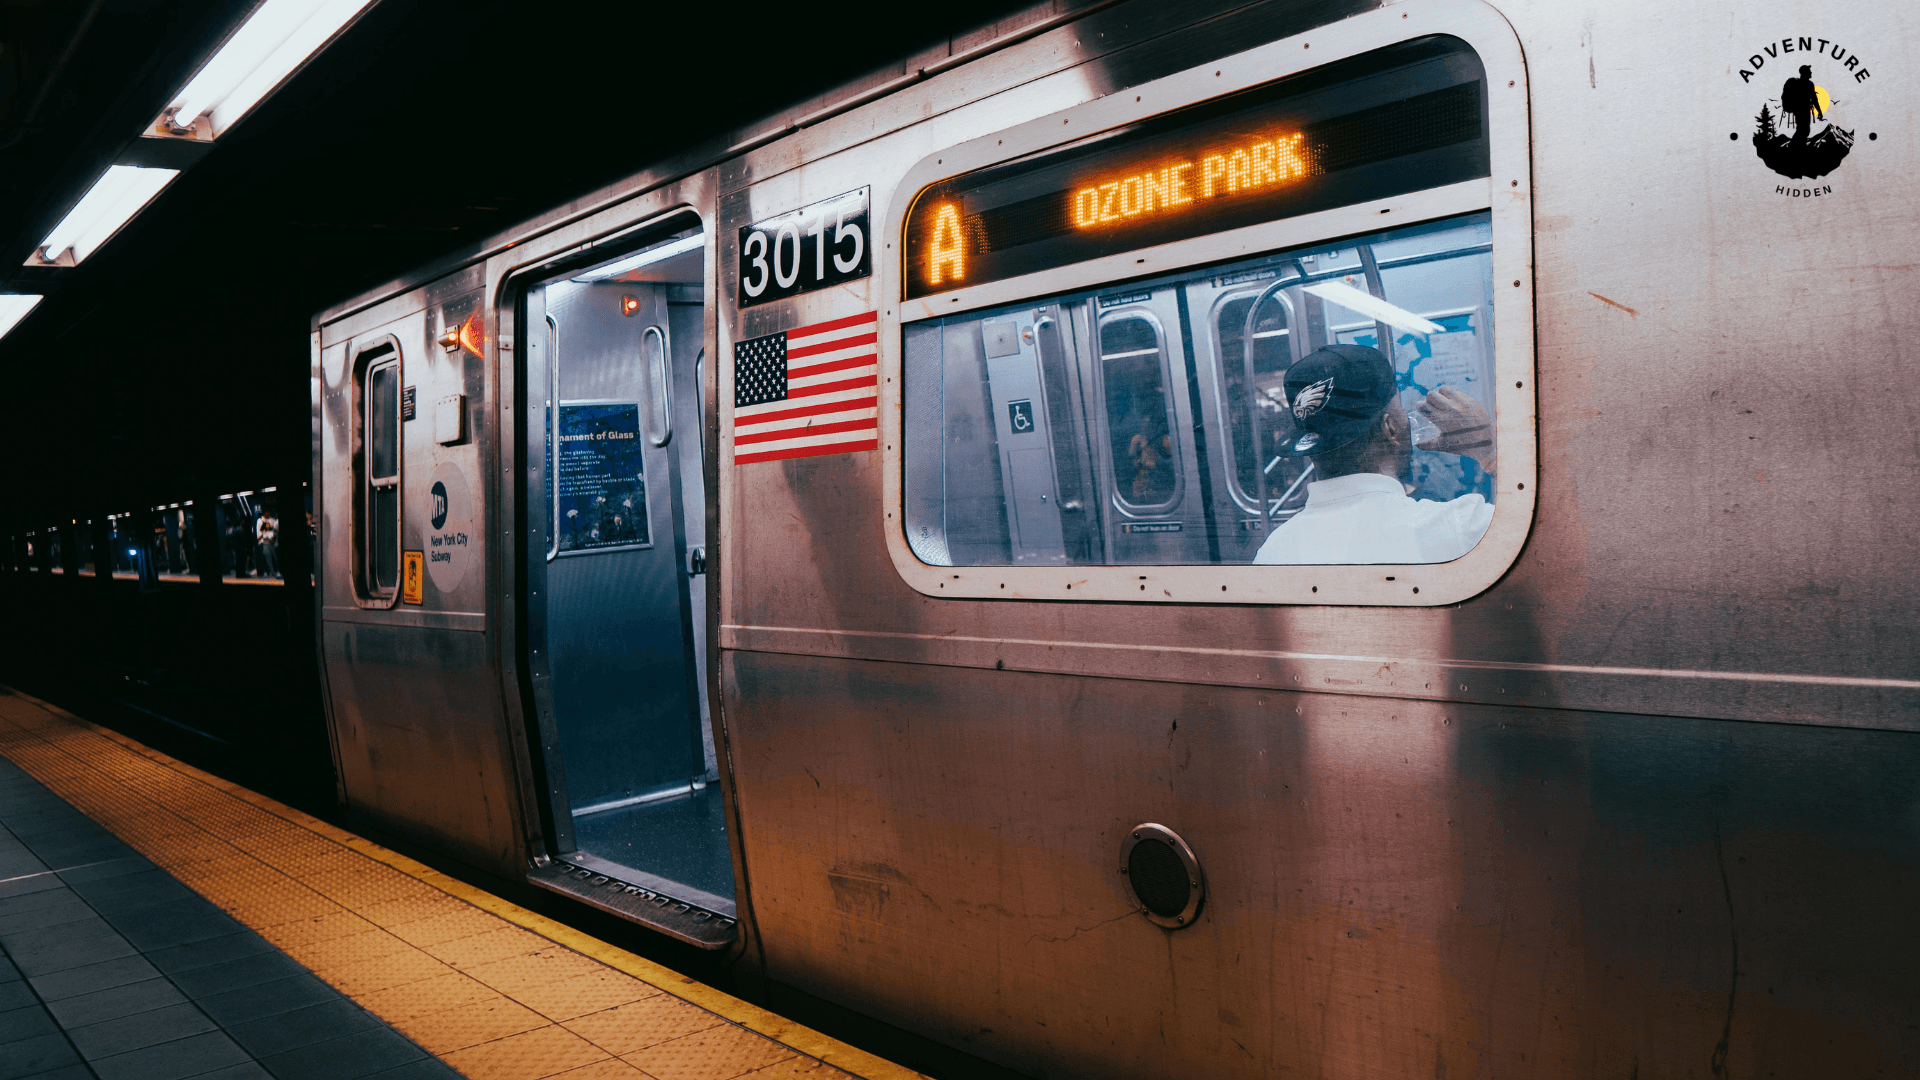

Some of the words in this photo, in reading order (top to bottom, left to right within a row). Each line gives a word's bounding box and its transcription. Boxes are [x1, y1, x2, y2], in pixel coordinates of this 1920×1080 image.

[1074, 161, 1193, 228] OZONE
[1203, 132, 1304, 197] PARK
[743, 197, 864, 297] 3015
[929, 203, 965, 285] A
[596, 431, 607, 440] of
[608, 430, 634, 440] Glass
[431, 493, 445, 520] MTA
[431, 534, 443, 548] New
[443, 533, 456, 546] York
[456, 532, 468, 547] City
[431, 550, 451, 564] Subway
